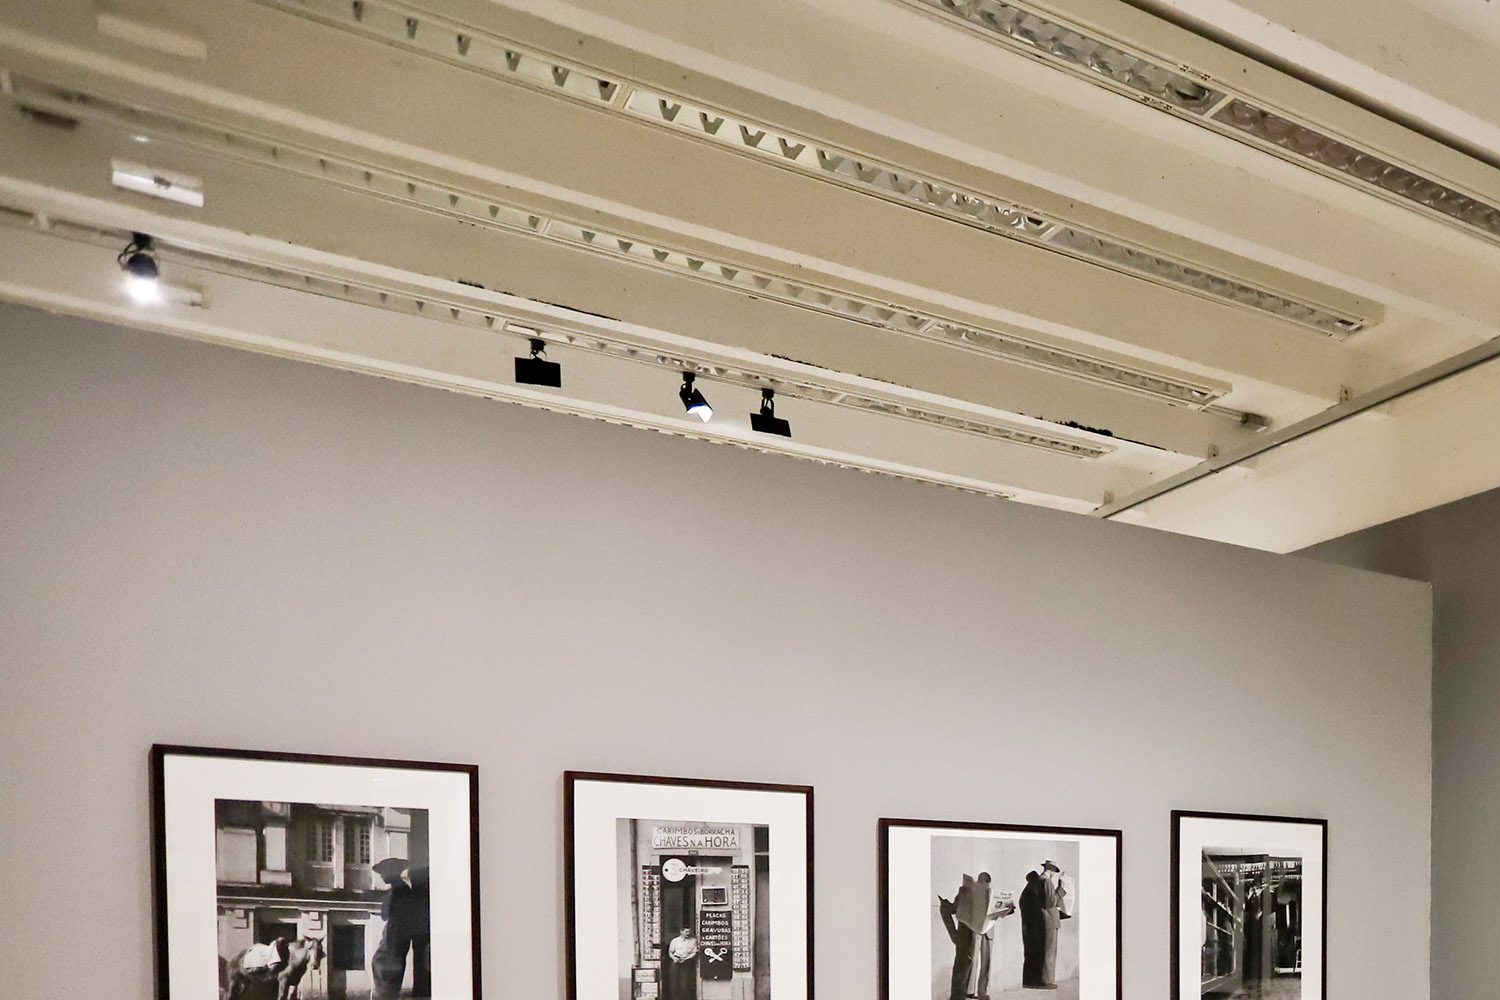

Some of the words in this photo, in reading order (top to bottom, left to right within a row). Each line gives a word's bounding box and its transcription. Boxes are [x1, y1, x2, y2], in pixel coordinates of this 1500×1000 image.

[657, 827, 698, 835] CARIMBOS
[700, 827, 736, 835] BORRACHA
[654, 835, 689, 847] CHAVES
[690, 839, 704, 847] NA
[705, 836, 737, 848] HORA
